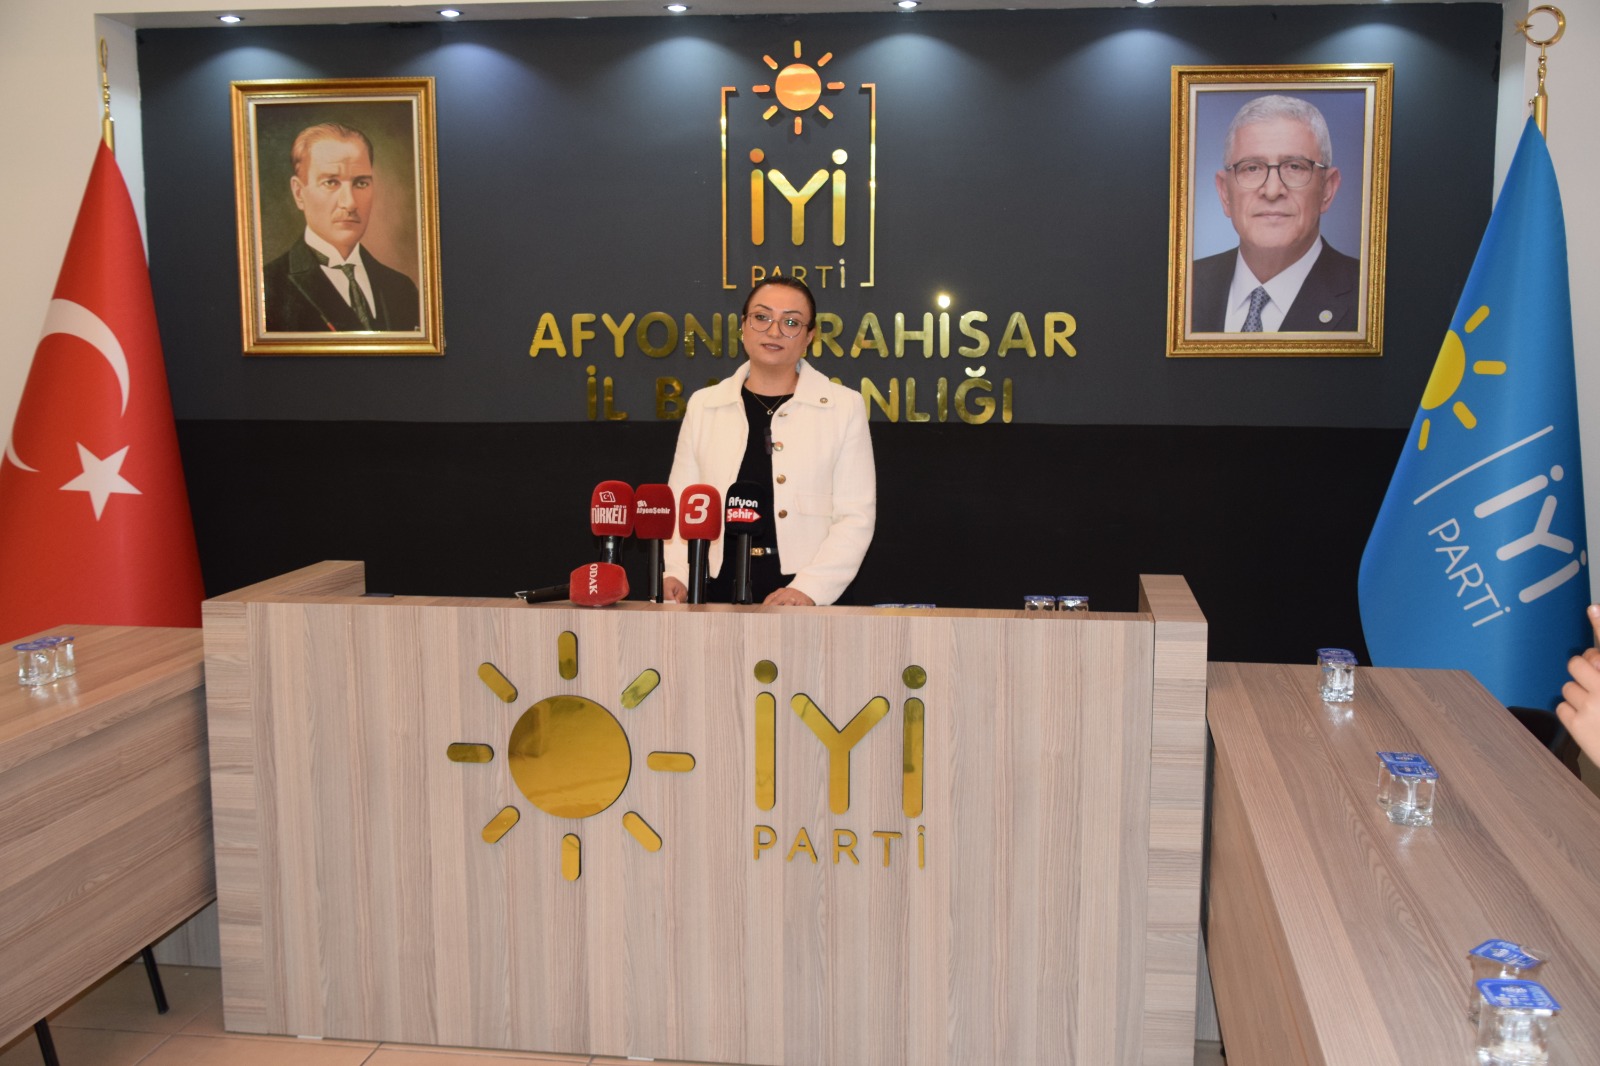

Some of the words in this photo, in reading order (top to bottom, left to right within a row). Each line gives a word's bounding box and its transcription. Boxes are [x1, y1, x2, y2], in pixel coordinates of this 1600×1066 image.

[749, 147, 848, 246] İYİ
[529, 295, 1077, 358] AFYONKRAHİSAR
[586, 364, 629, 421] İL
[655, 365, 1013, 425] BNLIĞI
[685, 493, 710, 524] 3
[727, 508, 753, 522] Şehir
[728, 496, 758, 509] Afyon
[589, 563, 599, 596] ODAK
[1427, 517, 1511, 628] PARTİ
[753, 659, 927, 818] İYİ
[752, 824, 926, 870] PARTİ
